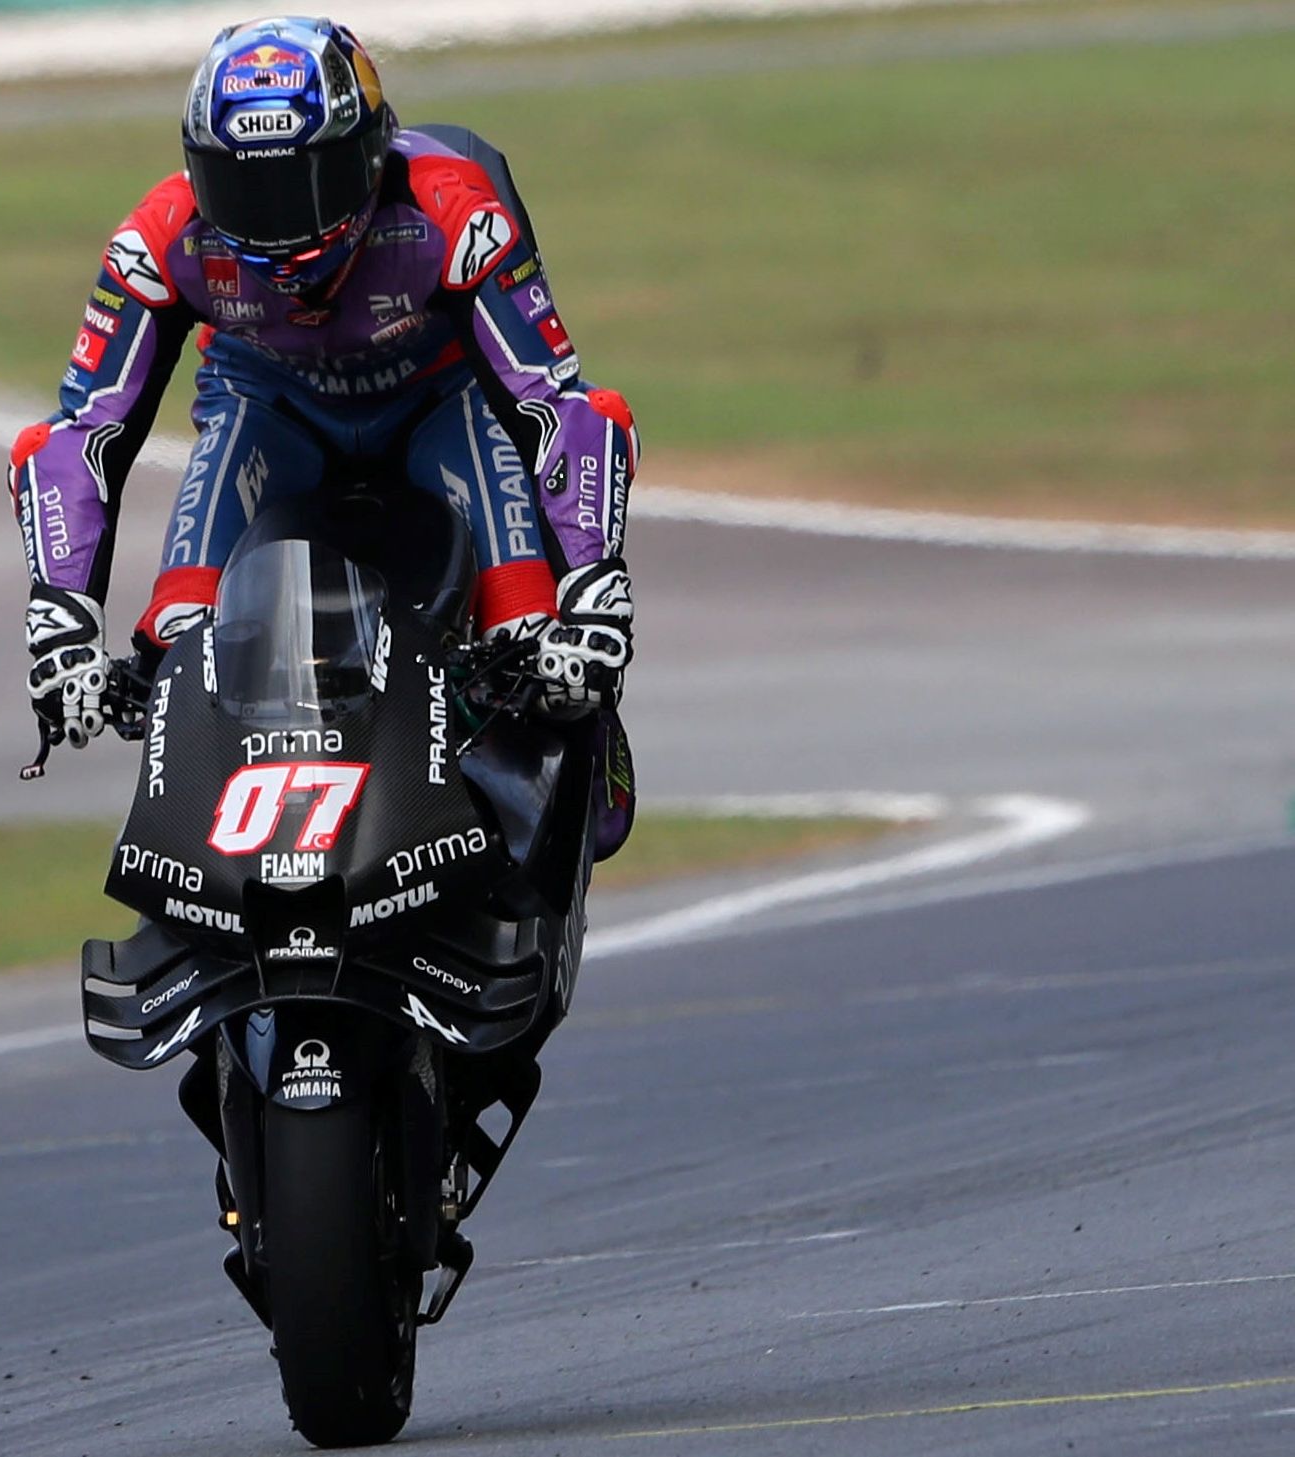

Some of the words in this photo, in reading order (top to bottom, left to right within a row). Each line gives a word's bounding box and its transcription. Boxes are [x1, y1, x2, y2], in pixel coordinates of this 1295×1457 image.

[267, 70, 305, 89] Bull
[238, 114, 292, 134] SHOEI
[207, 279, 236, 293] EAE
[213, 299, 264, 319] FIAMM
[168, 411, 226, 566] PRAMAC
[578, 455, 601, 531] prima
[18, 490, 41, 583] PRAMAC
[39, 485, 71, 560] prima
[148, 677, 172, 799] PRAMAC
[428, 665, 447, 785] PRAMAC
[240, 729, 343, 765] prima
[206, 760, 372, 857] 07
[119, 843, 204, 892] prima
[261, 852, 325, 877] FIAMM
[386, 827, 488, 887] prima
[165, 897, 245, 934] MOTUL
[349, 881, 440, 928] MOTUL
[268, 946, 336, 958] PRAMAC
[281, 1068, 343, 1082] PRAMAC
[282, 1081, 342, 1100] YAMAHA
